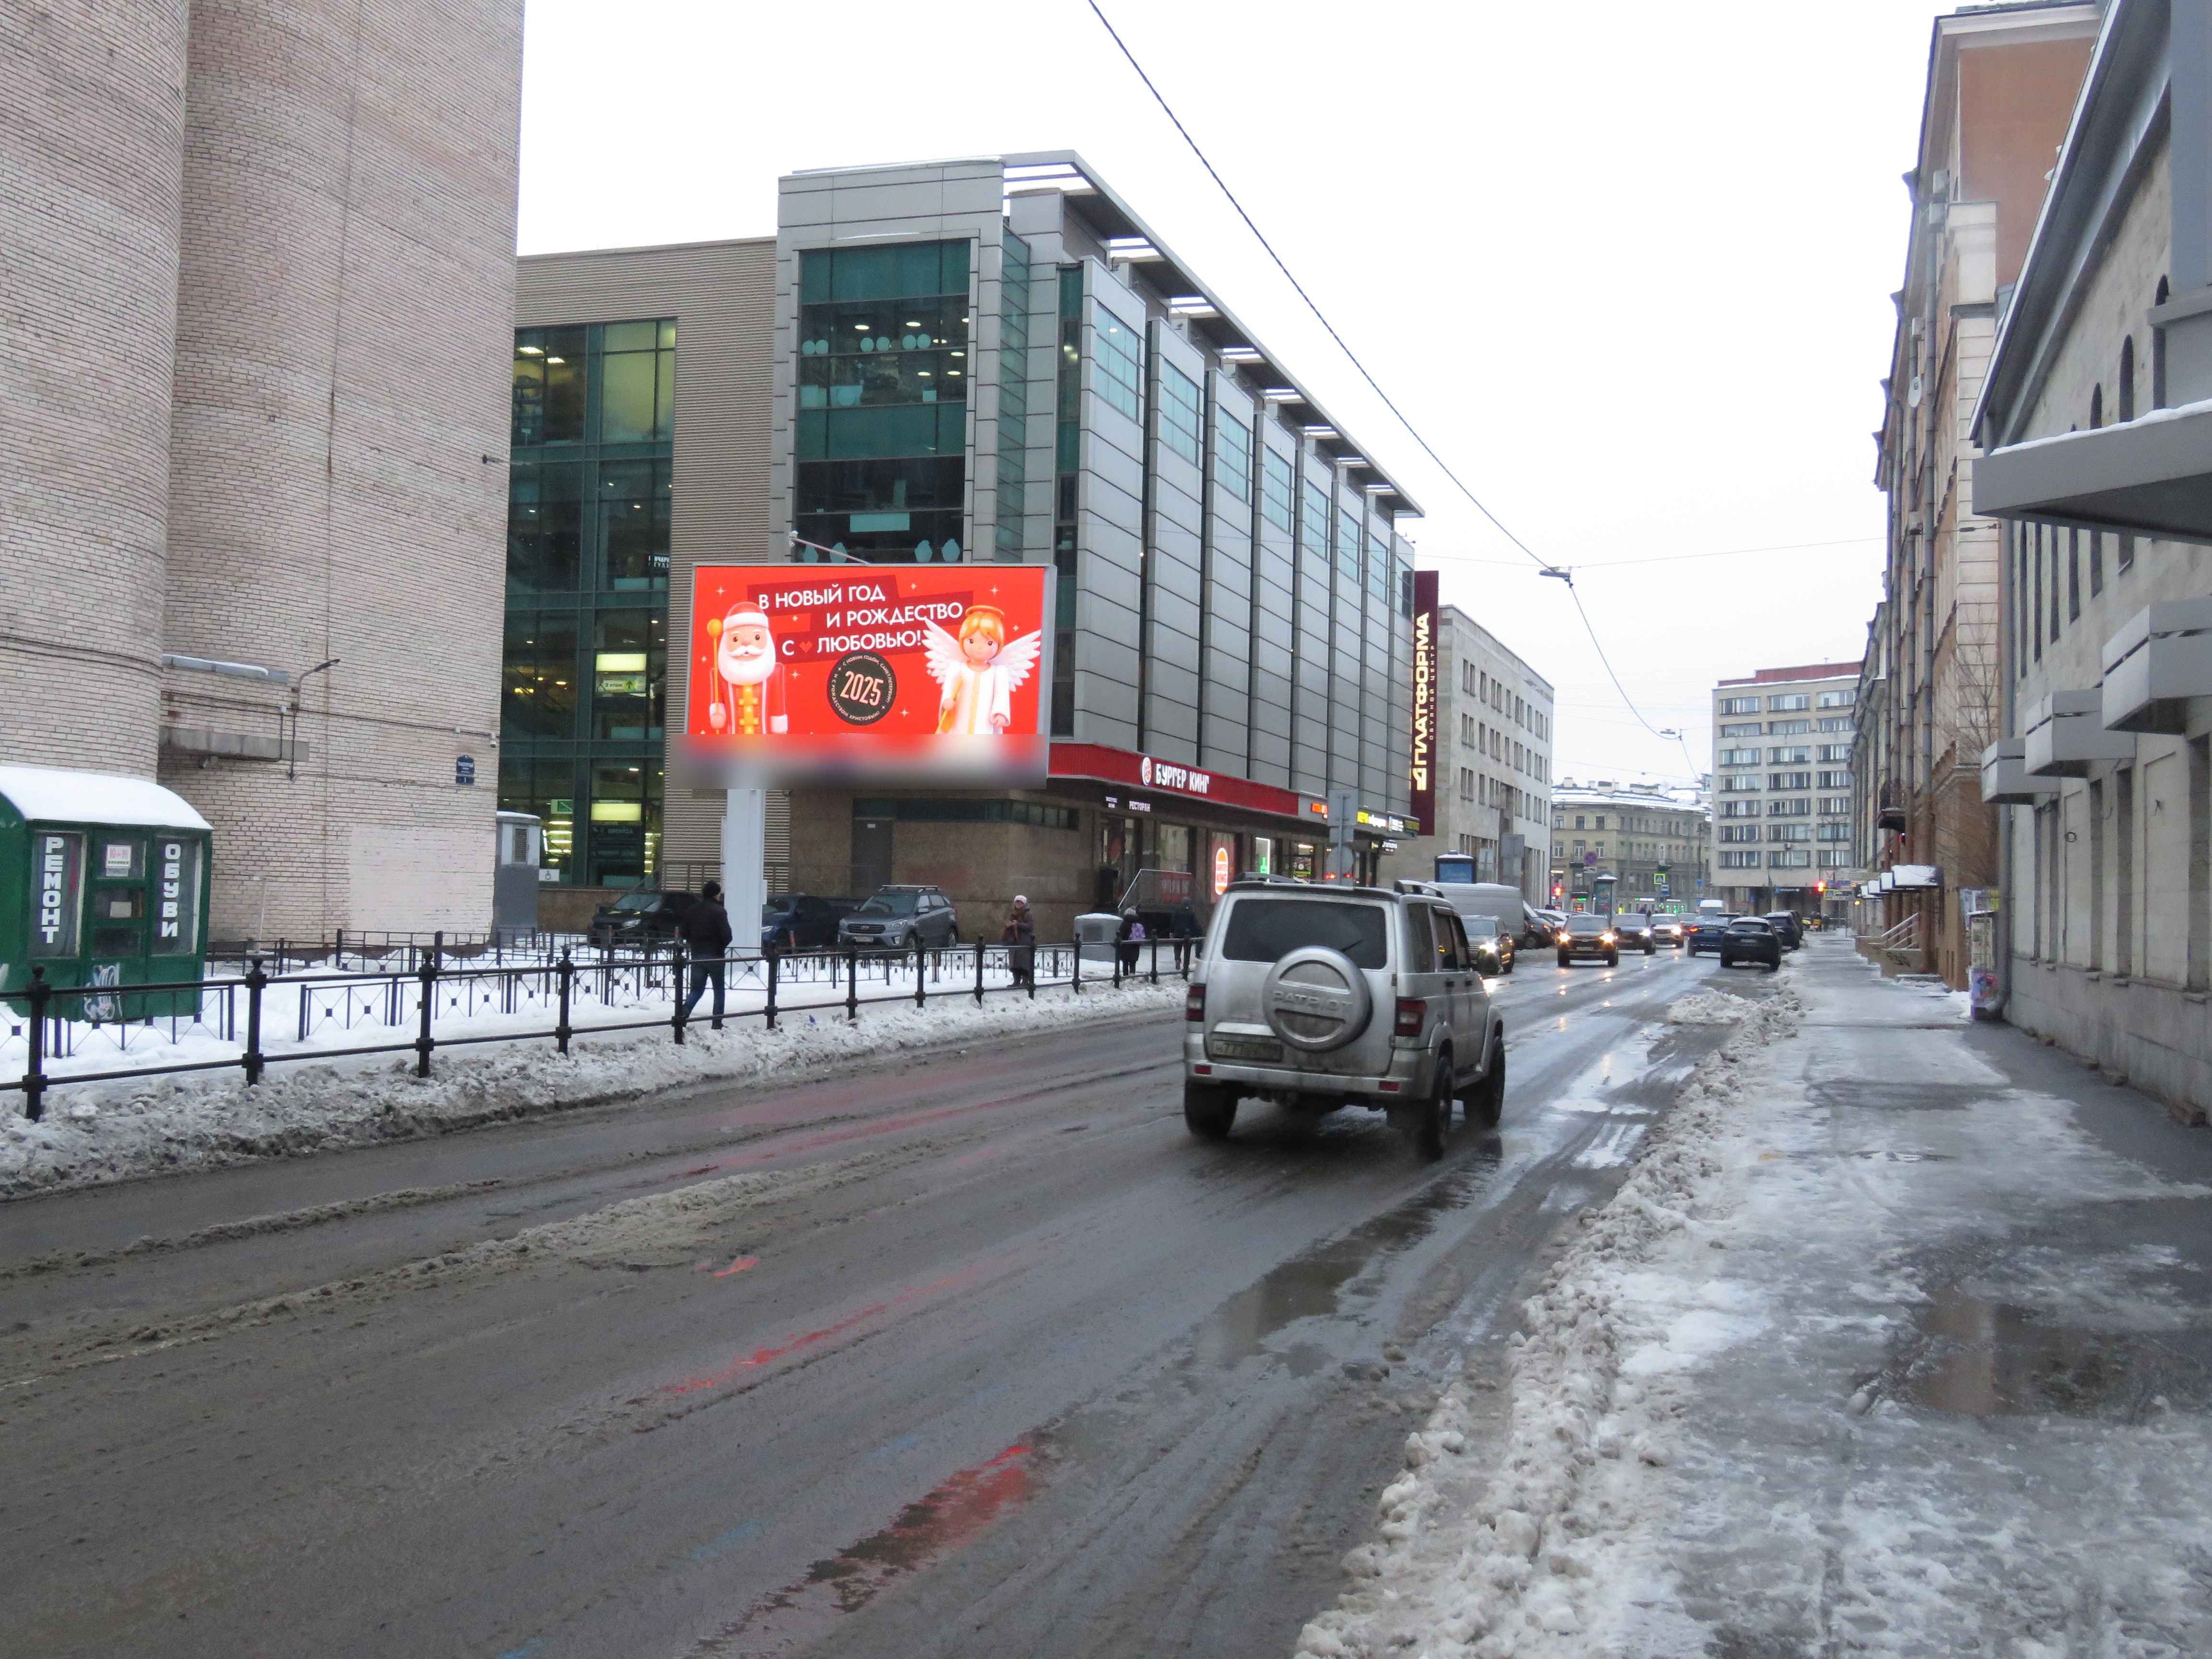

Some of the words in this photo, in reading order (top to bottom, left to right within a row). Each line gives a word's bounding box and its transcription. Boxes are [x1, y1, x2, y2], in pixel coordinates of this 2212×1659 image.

[758, 594, 769, 610] В
[775, 584, 842, 609] НОВЫЙ
[848, 584, 885, 603] ГОД
[826, 612, 840, 628] И
[847, 602, 963, 627] РОЖДЕСТВО
[781, 640, 794, 656] С
[817, 629, 922, 654] ЛЮБОВЬЮ!
[840, 671, 884, 706] 2025
[1413, 612, 1429, 766] ПЛАТФОРМА
[1155, 763, 1187, 789] БУРГЕР
[1189, 771, 1210, 794] КИНГ
[1129, 800, 1151, 812] РЕСТОРАН
[42, 836, 65, 944] РЕМОНТ
[161, 843, 181, 938] ОБУВИ
[1273, 990, 1353, 1012] PATRIOT
